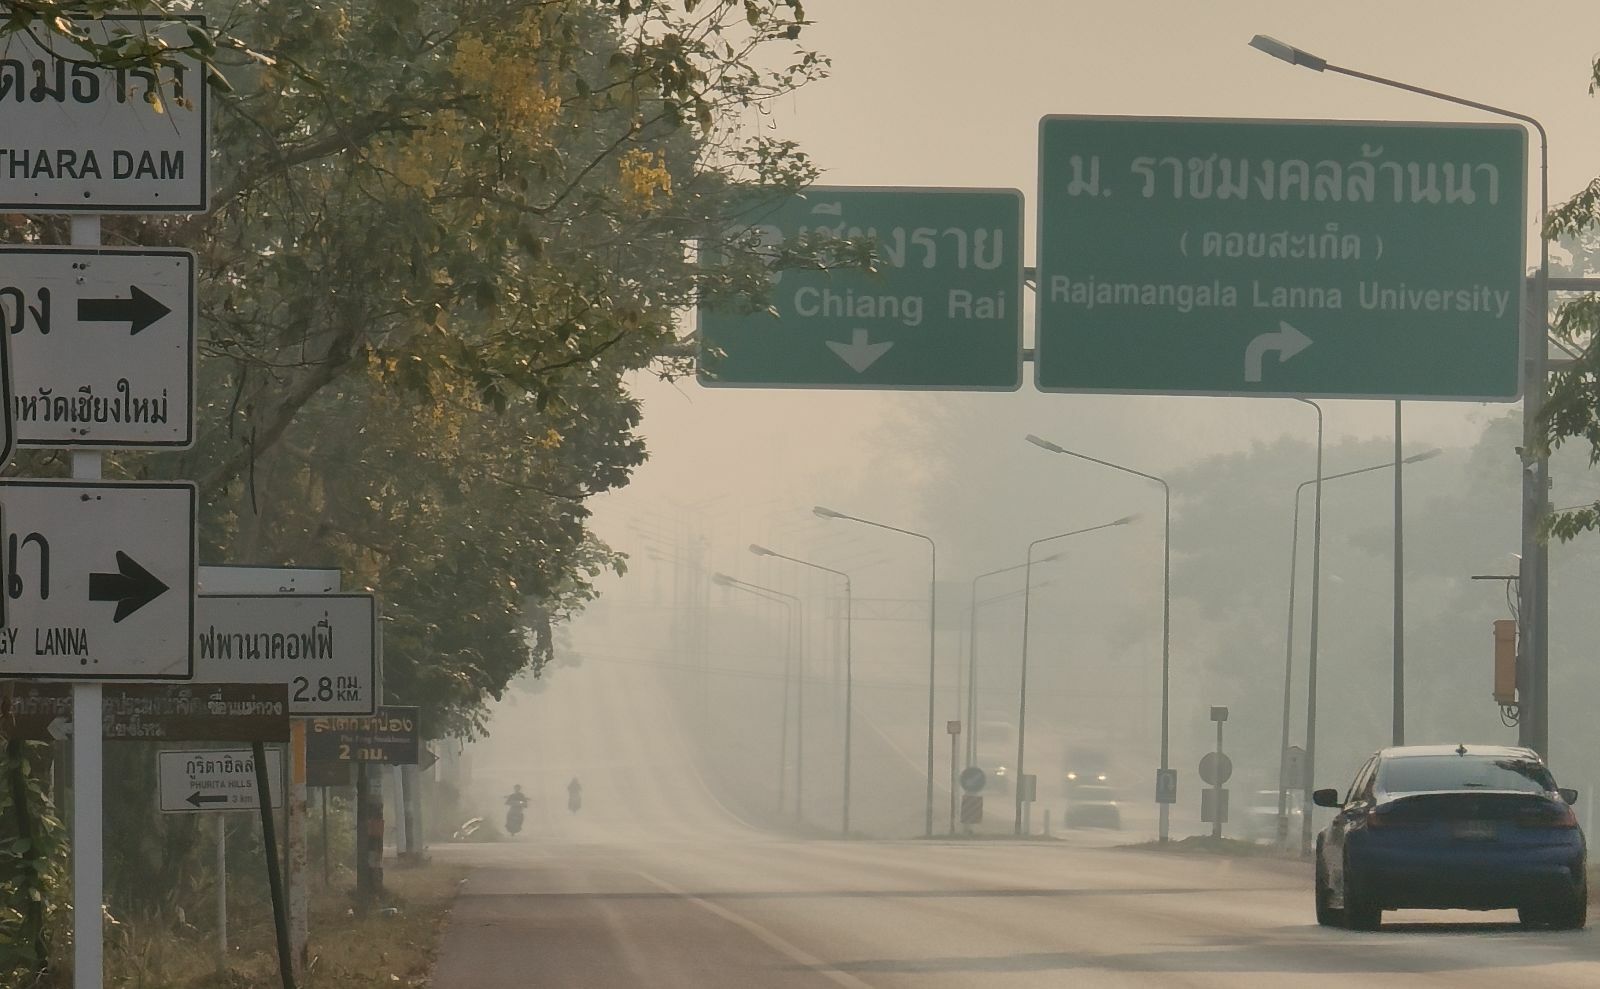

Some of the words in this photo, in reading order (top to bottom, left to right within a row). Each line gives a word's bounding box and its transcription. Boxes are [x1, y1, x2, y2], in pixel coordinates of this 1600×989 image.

[113, 150, 184, 180] DAM
[1067, 154, 1112, 197] ม.
[1130, 143, 1499, 205] ราชมงคลล้านนา
[793, 286, 924, 327] Chiang
[949, 289, 1005, 319] Rai
[1051, 275, 1237, 313] Rajamangala
[1253, 280, 1342, 309] Lanna
[1359, 281, 1510, 319] University
[15, 378, 168, 424] หวัดเชียงใหม่
[35, 627, 88, 656] LANNA
[293, 676, 333, 702] 2.8
[339, 745, 350, 760] 2
